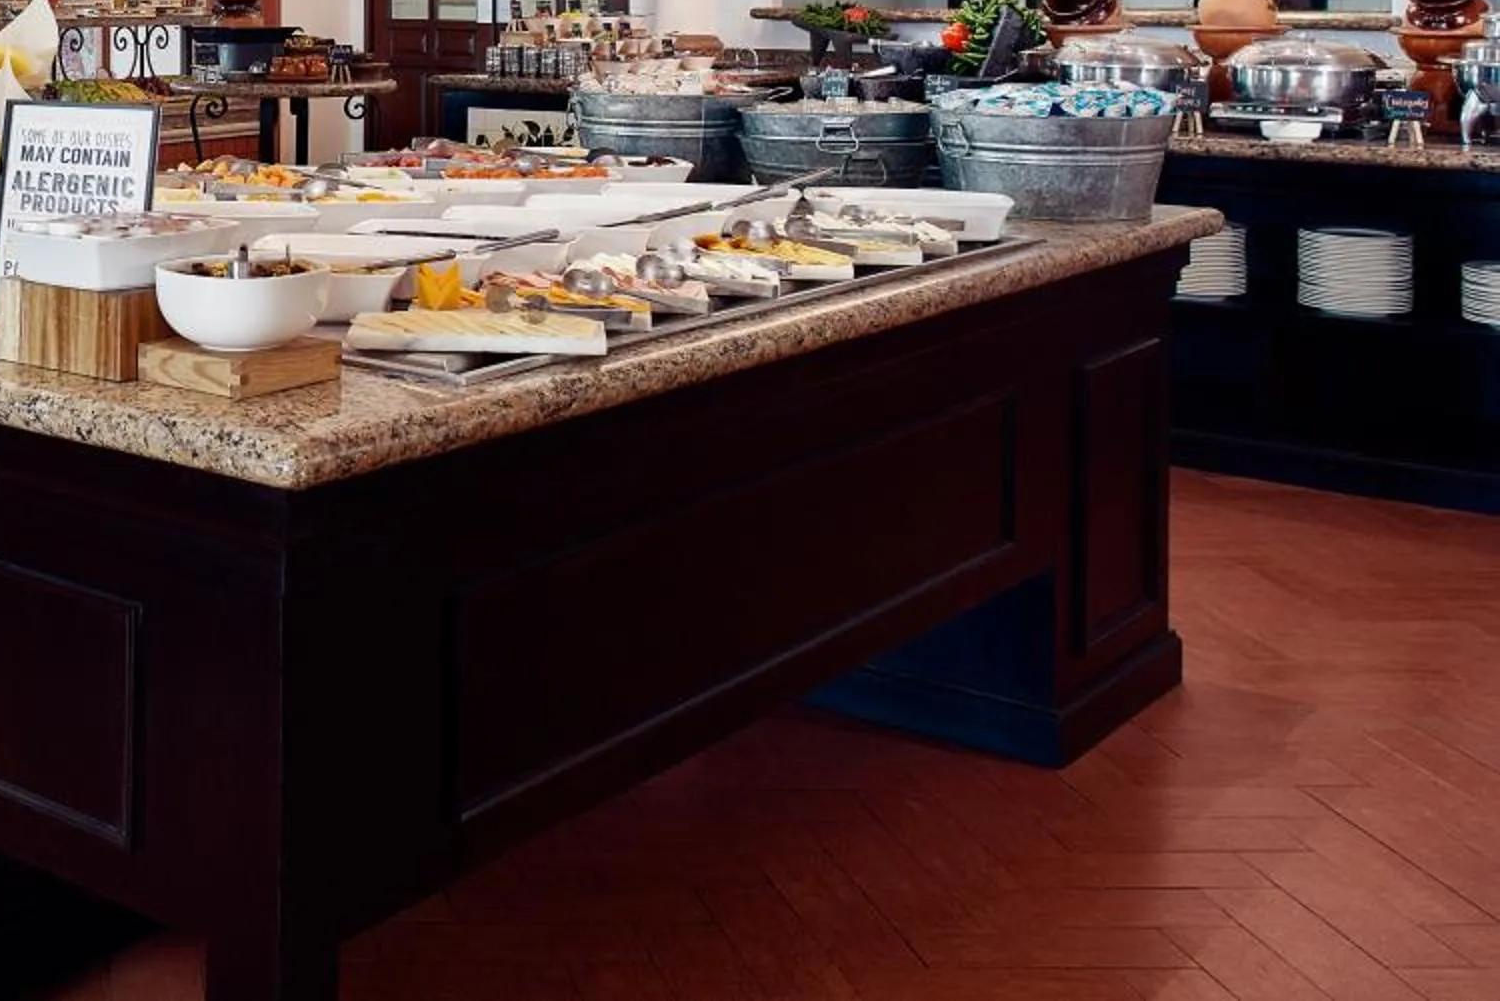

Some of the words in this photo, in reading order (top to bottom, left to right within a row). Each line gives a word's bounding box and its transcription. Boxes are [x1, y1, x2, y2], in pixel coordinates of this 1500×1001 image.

[20, 145, 55, 163] MAY
[60, 147, 131, 167] CONTAIN
[11, 170, 135, 199] ALERGENIC
